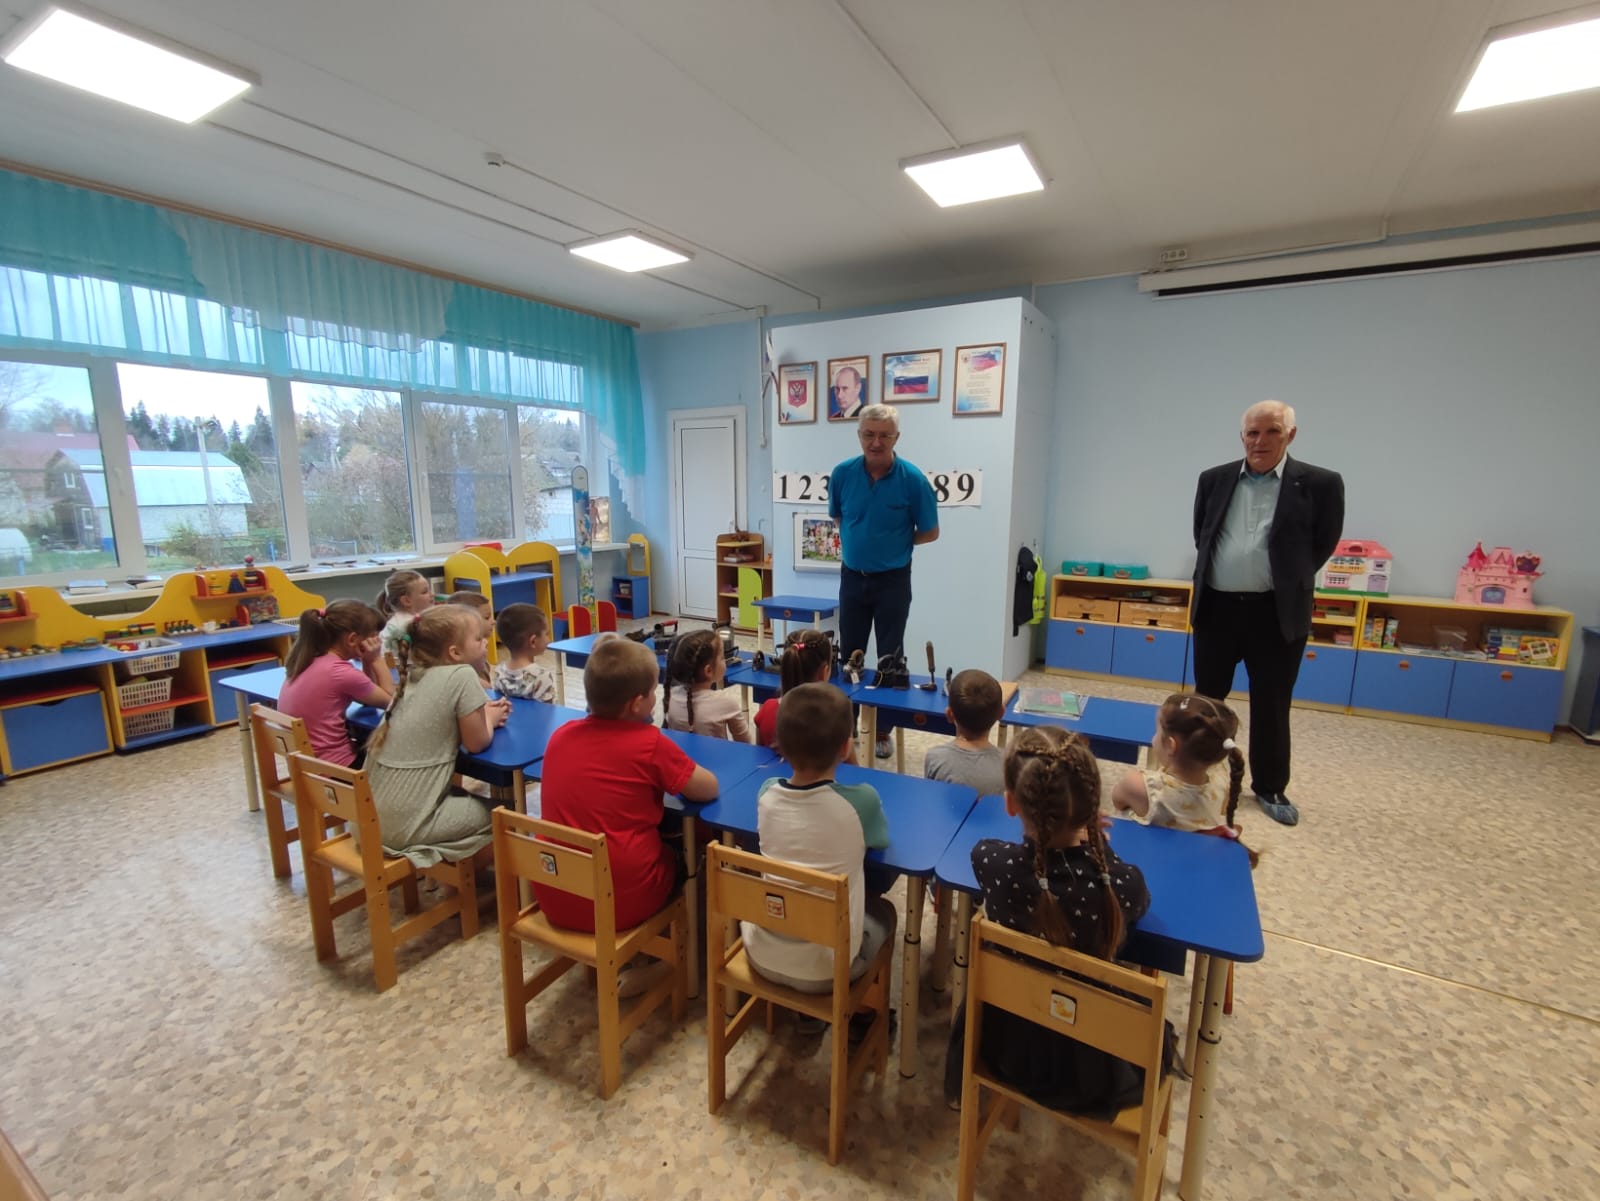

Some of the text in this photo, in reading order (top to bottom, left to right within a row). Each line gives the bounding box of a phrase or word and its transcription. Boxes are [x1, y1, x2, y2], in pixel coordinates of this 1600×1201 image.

[798, 474, 811, 500] 2
[934, 474, 950, 503] 8
[956, 473, 975, 502] 9
